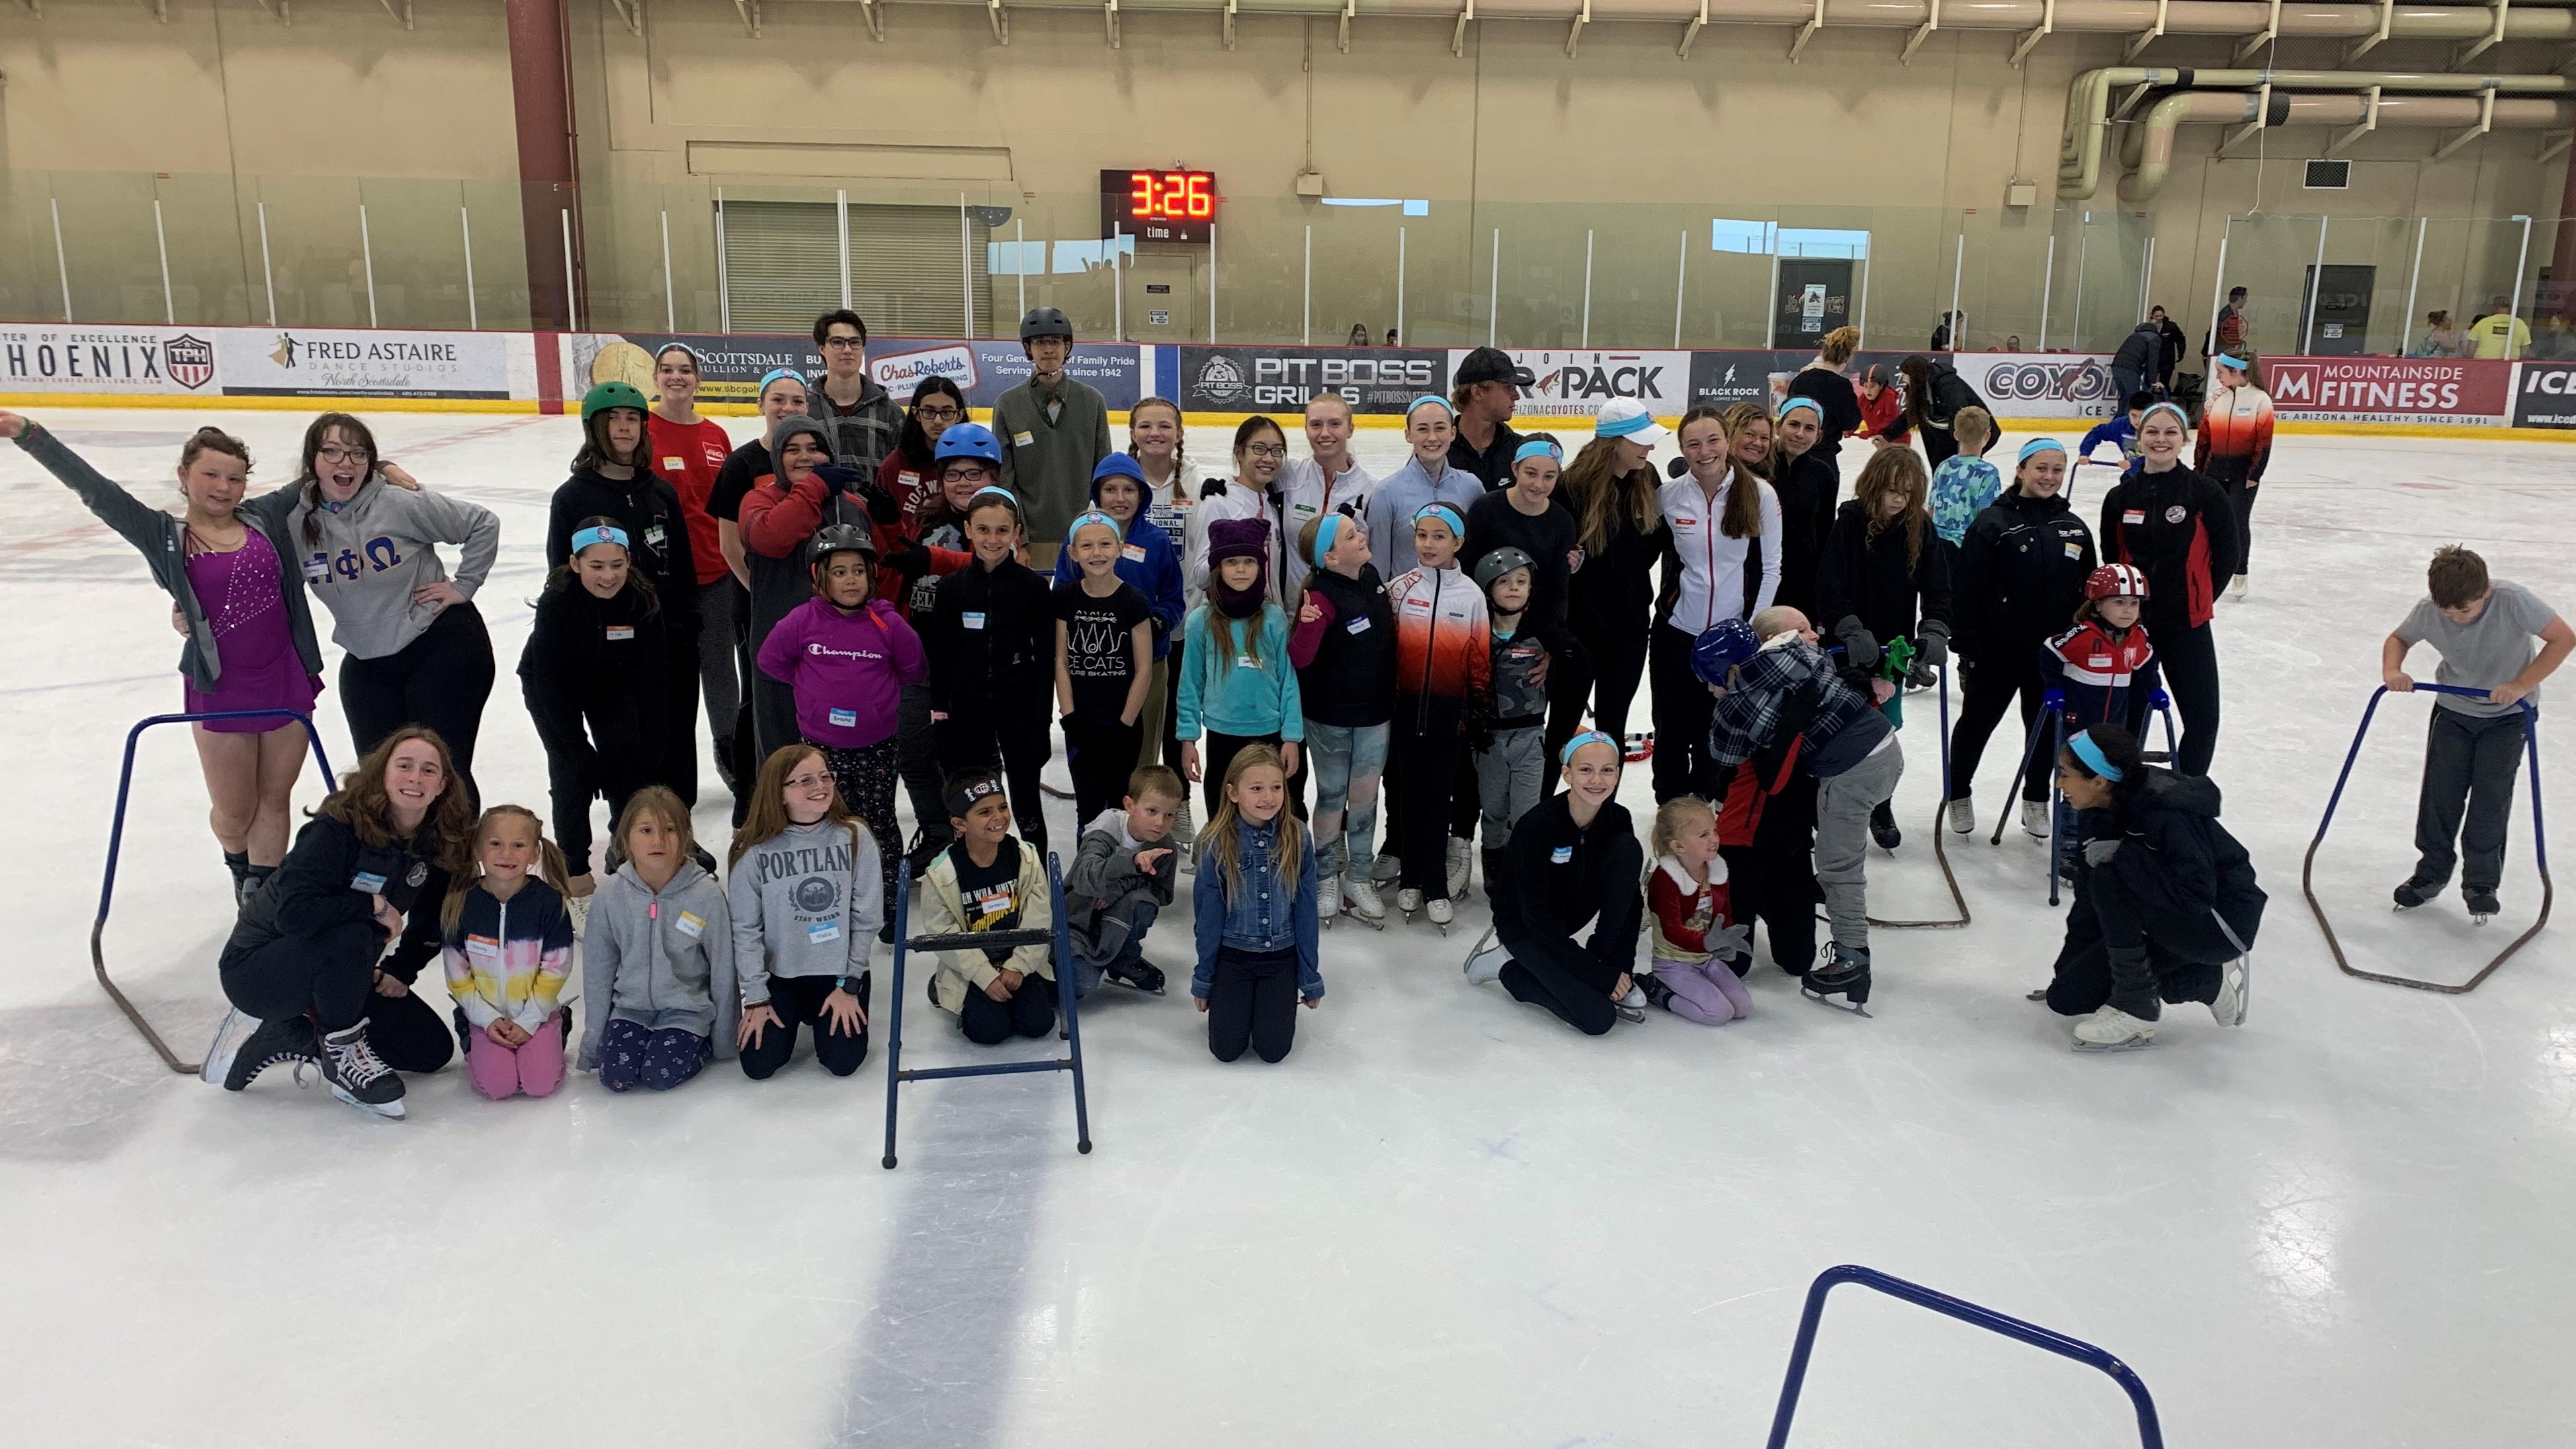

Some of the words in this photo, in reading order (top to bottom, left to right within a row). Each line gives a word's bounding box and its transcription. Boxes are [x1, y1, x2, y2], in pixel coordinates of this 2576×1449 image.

[1132, 174, 1210, 216] 3:26
[1147, 227, 1170, 238] time
[42, 333, 57, 342] OF
[71, 334, 157, 343] EXCELLENCE
[170, 348, 208, 363] TPH
[307, 341, 361, 359] FRED
[368, 343, 457, 361] ASTAIRE
[695, 349, 794, 365] SCOTTSDALE
[7, 344, 160, 378] HOENIX
[806, 355, 822, 364] BU
[982, 353, 1004, 362] Four
[1078, 356, 1108, 367] Family
[1111, 357, 1135, 365] Pride
[381, 364, 457, 373] STUDIOS
[996, 366, 1032, 376] Serving
[1100, 369, 1121, 377] 1942
[1255, 358, 1317, 384] PIT
[1322, 359, 1432, 385] BOSS
[2323, 365, 2464, 380] MOUNTAINSIDE
[322, 373, 355, 387] North
[358, 373, 410, 388] Scottsdale
[1561, 367, 1664, 399] PACK
[1699, 388, 1731, 396] BLACK
[1733, 388, 1760, 396] ROCK
[2321, 381, 2460, 409] FITNESS
[1514, 405, 1598, 415] RIZONACOYOTES.CO
[2079, 406, 2102, 416] ICE
[2353, 414, 2410, 422] HEALTHY
[808, 643, 882, 660] Champion
[1084, 656, 1125, 670] CATS
[759, 844, 853, 885] PORTLAN
